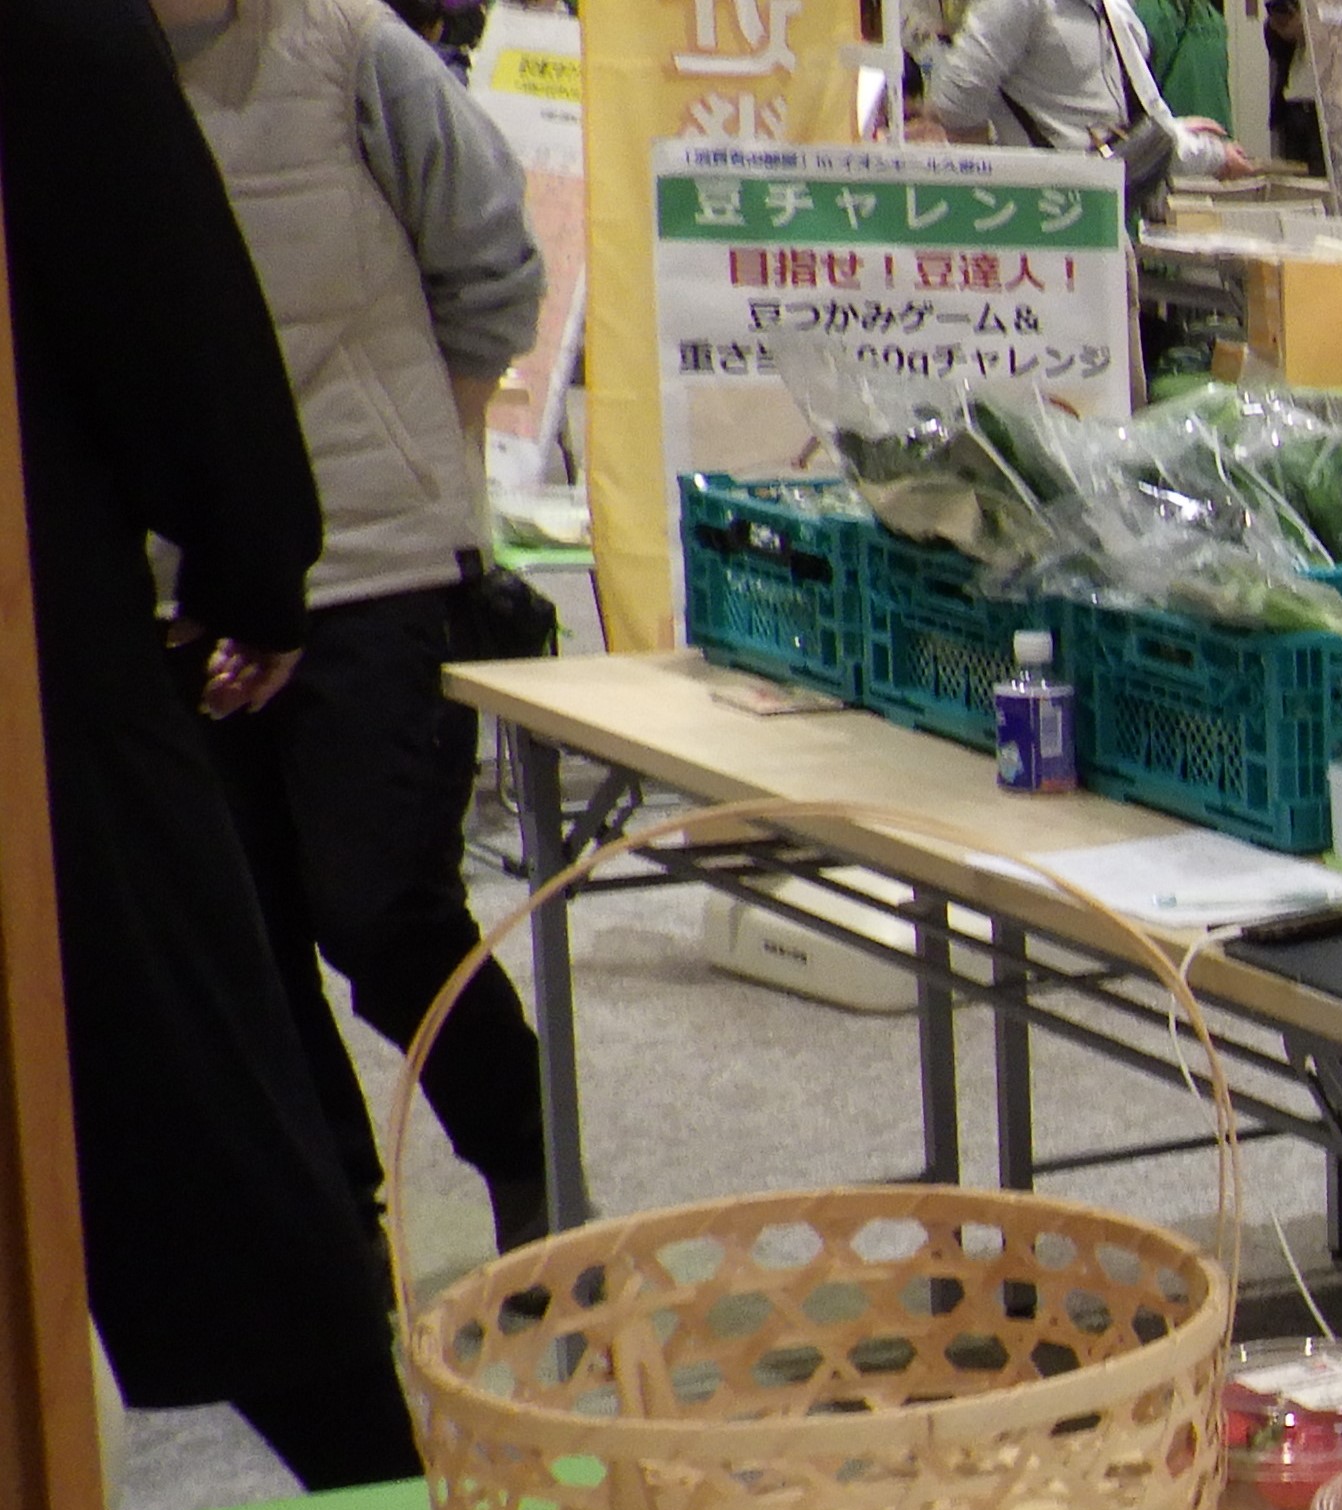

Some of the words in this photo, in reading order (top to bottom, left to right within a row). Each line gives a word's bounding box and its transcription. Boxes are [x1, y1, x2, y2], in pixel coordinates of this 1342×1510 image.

[694, 176, 1085, 234] 豆チャレンジ
[728, 248, 1077, 293] 目指せ！豆達人！
